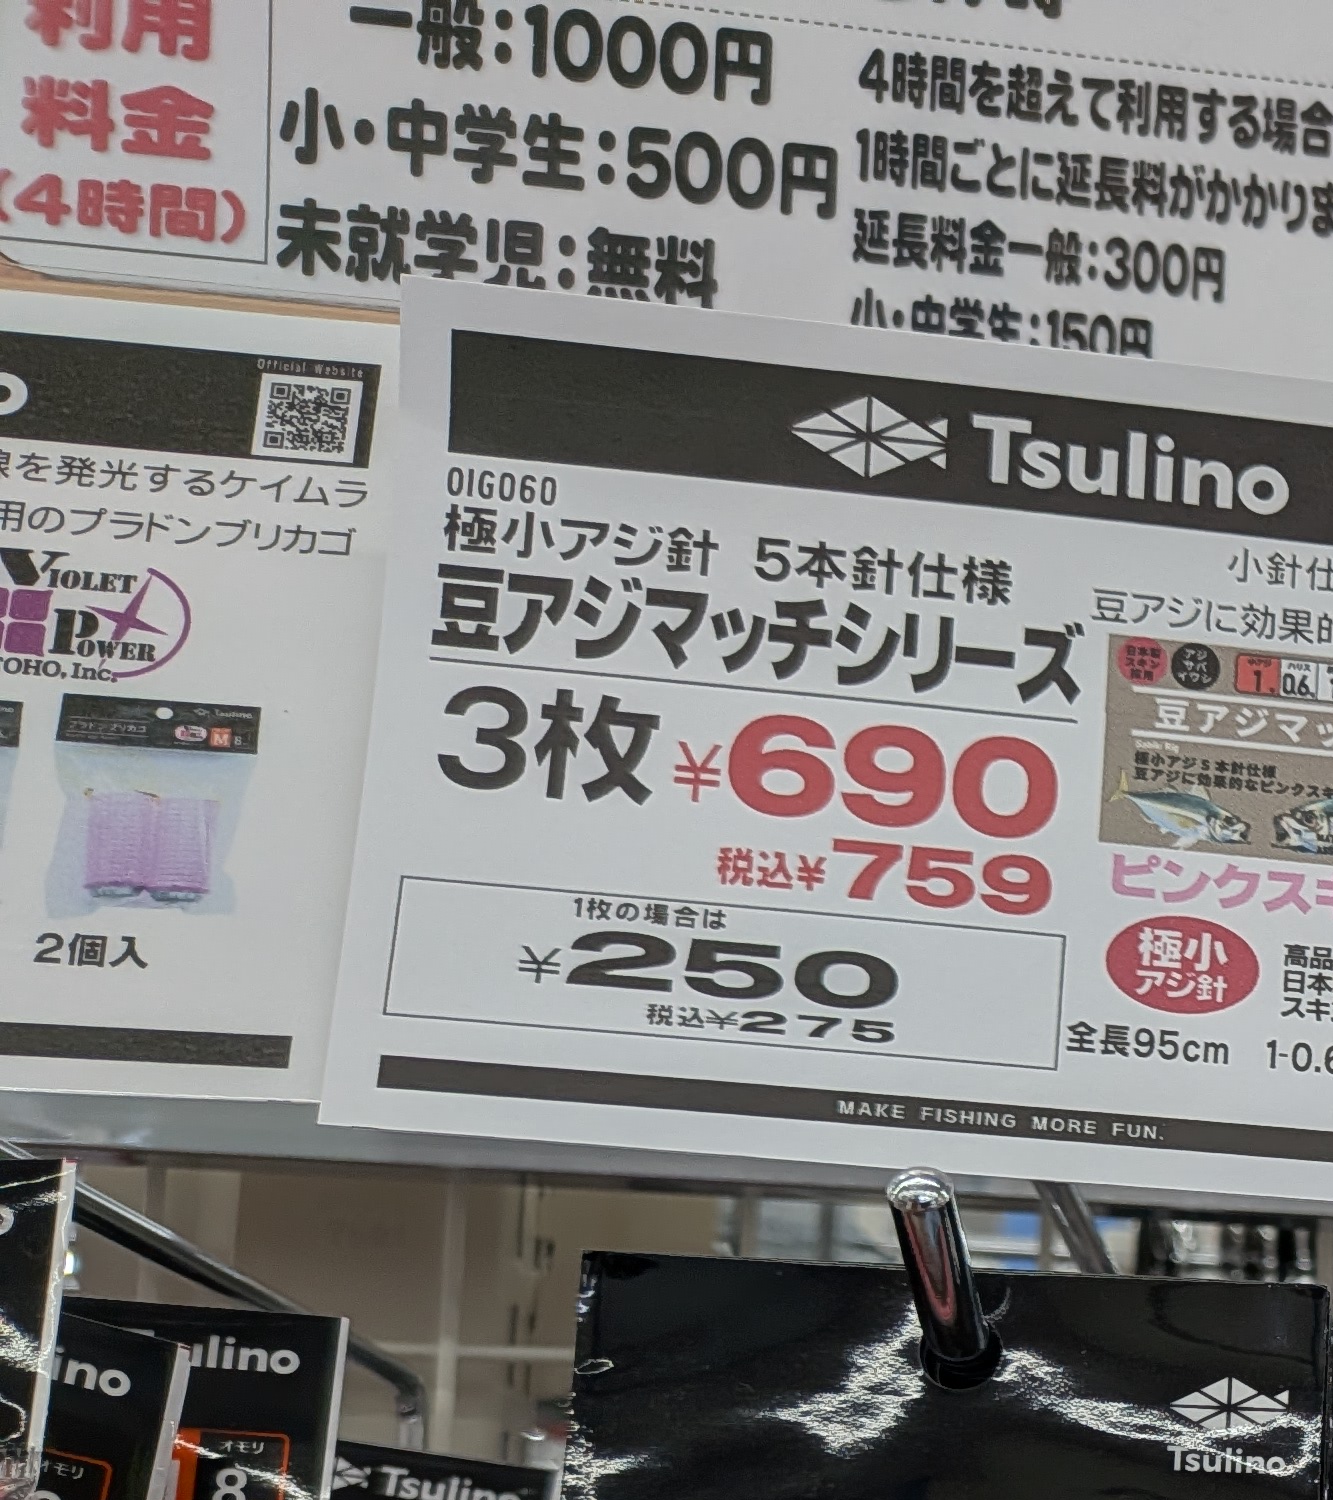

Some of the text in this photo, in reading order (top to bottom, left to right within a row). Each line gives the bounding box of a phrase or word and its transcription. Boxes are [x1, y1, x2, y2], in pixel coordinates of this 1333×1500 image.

[22, 74, 215, 162] 料金
[970, 413, 1290, 517] Tsulino
[444, 504, 1012, 607] 極小アジ針 5本針仕様
[48, 608, 156, 662] POWER
[430, 563, 1085, 705] 豆アジマッチシリーズ
[437, 685, 1058, 839] 3枚 ¥690
[717, 839, 1053, 916] 税込¥759
[573, 897, 728, 931] 1枚の場合は
[34, 932, 149, 970] 2個入
[518, 931, 900, 1010] ¥250
[1137, 928, 1229, 968] 極小
[1134, 966, 1229, 1004] アジ針
[646, 1003, 896, 1044] 税込¥275
[1066, 1021, 1230, 1067] 全長95cm
[838, 1099, 1165, 1142] MAKE FISHING MORE FUN.
[1167, 1444, 1287, 1477] Tsulino
